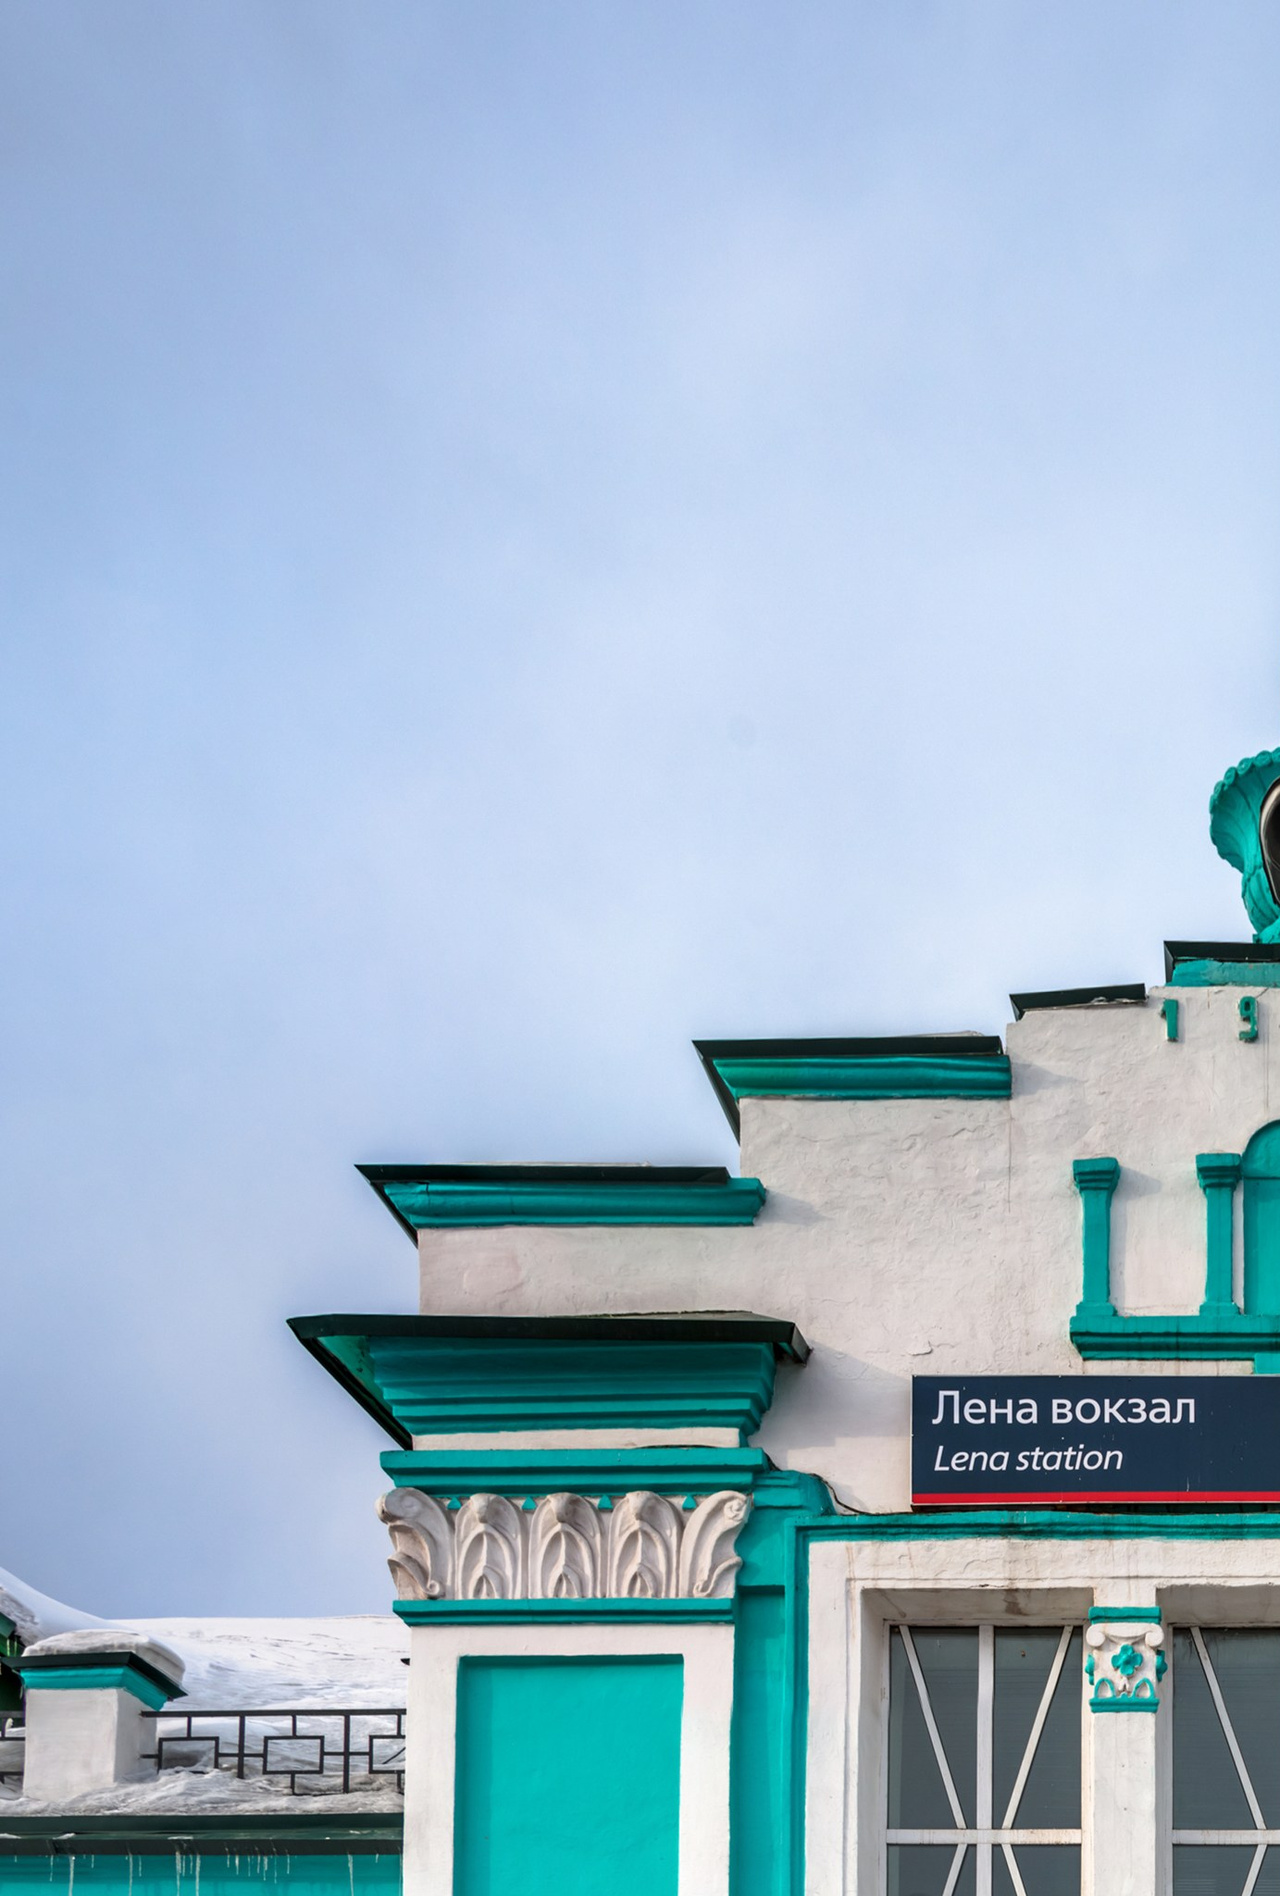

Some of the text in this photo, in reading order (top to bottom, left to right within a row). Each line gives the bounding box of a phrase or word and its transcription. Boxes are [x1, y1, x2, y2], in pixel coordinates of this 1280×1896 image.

[931, 1390, 1196, 1425] Лена вокзал
[933, 1443, 1124, 1472] Lena station
